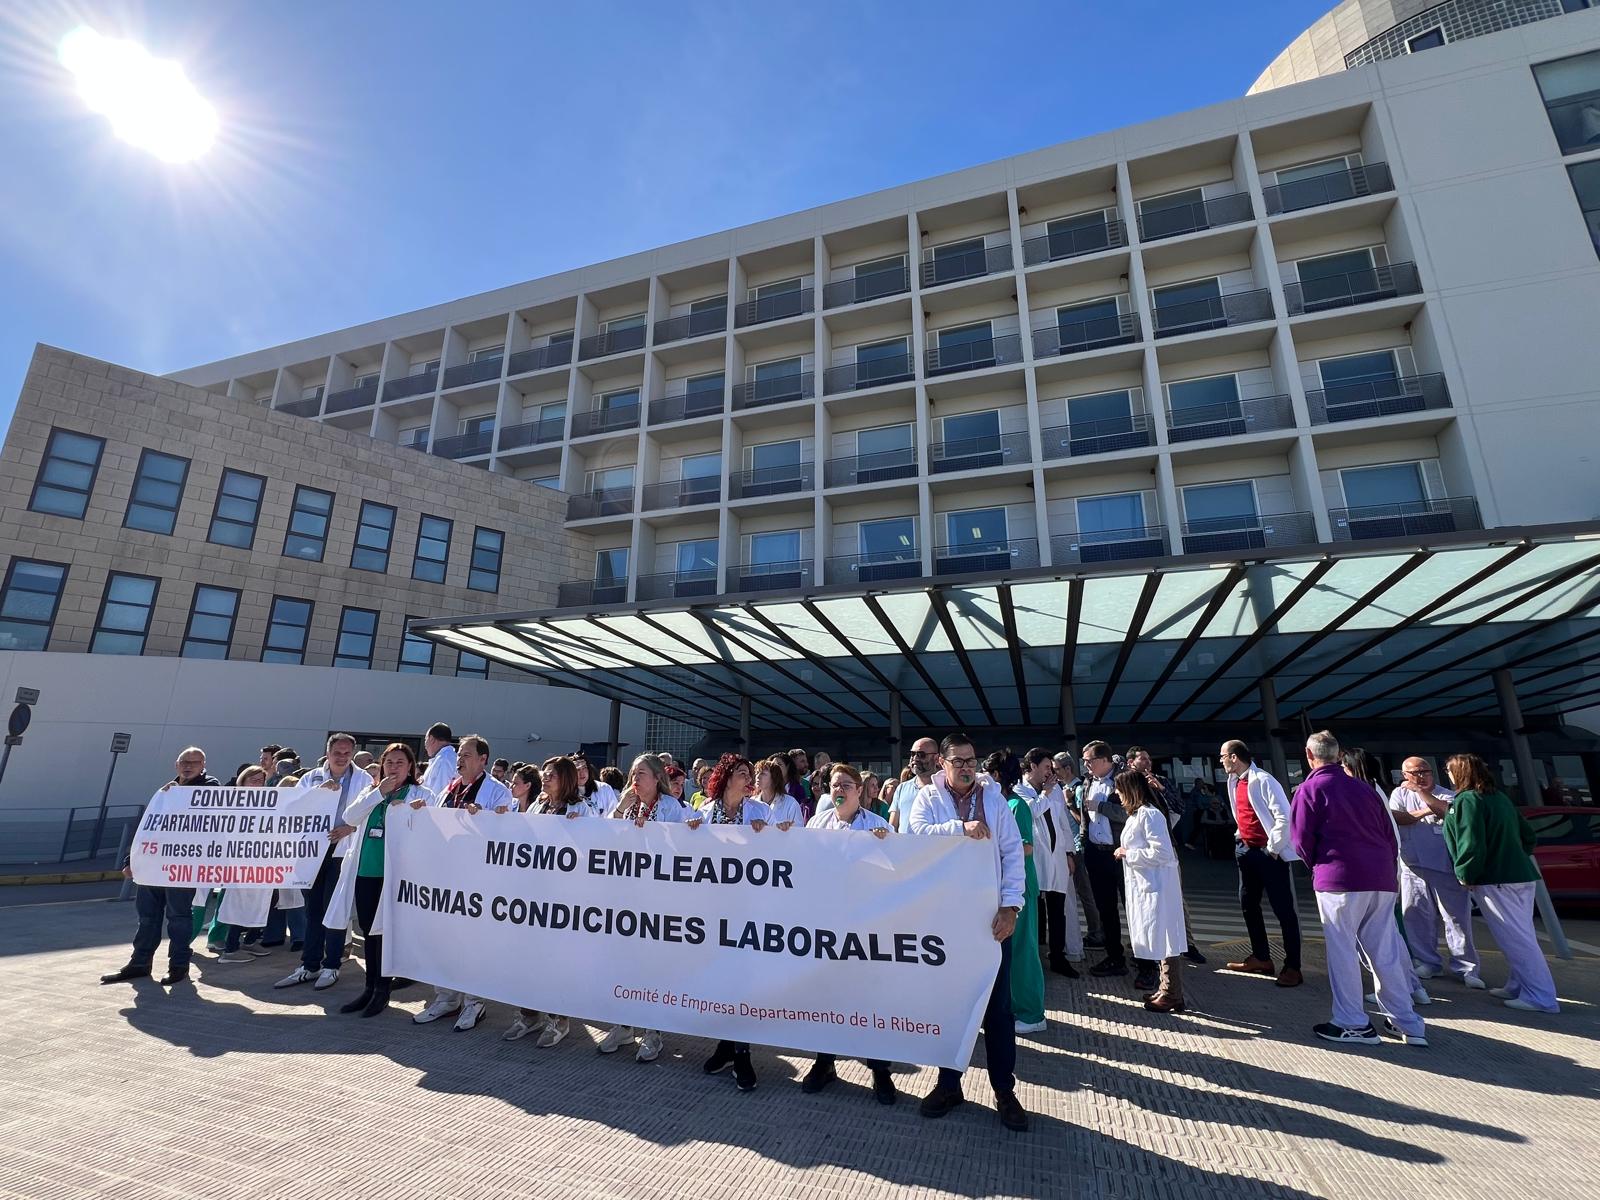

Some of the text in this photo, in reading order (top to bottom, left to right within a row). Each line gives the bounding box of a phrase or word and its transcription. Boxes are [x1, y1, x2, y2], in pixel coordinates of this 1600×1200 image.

[190, 789, 278, 808] CONVENIO
[239, 815, 256, 833] DE
[259, 816, 274, 834] LA
[278, 815, 331, 834] RIBERA
[142, 835, 319, 859] 75 meses de NEGOCIACIÓN
[485, 840, 794, 889] MISMO EMPLEADOR
[397, 879, 947, 967] MISMAS CONDICIONES LABORALES
[613, 984, 941, 1036] Comité de Empresa Departamento de la Ribera
